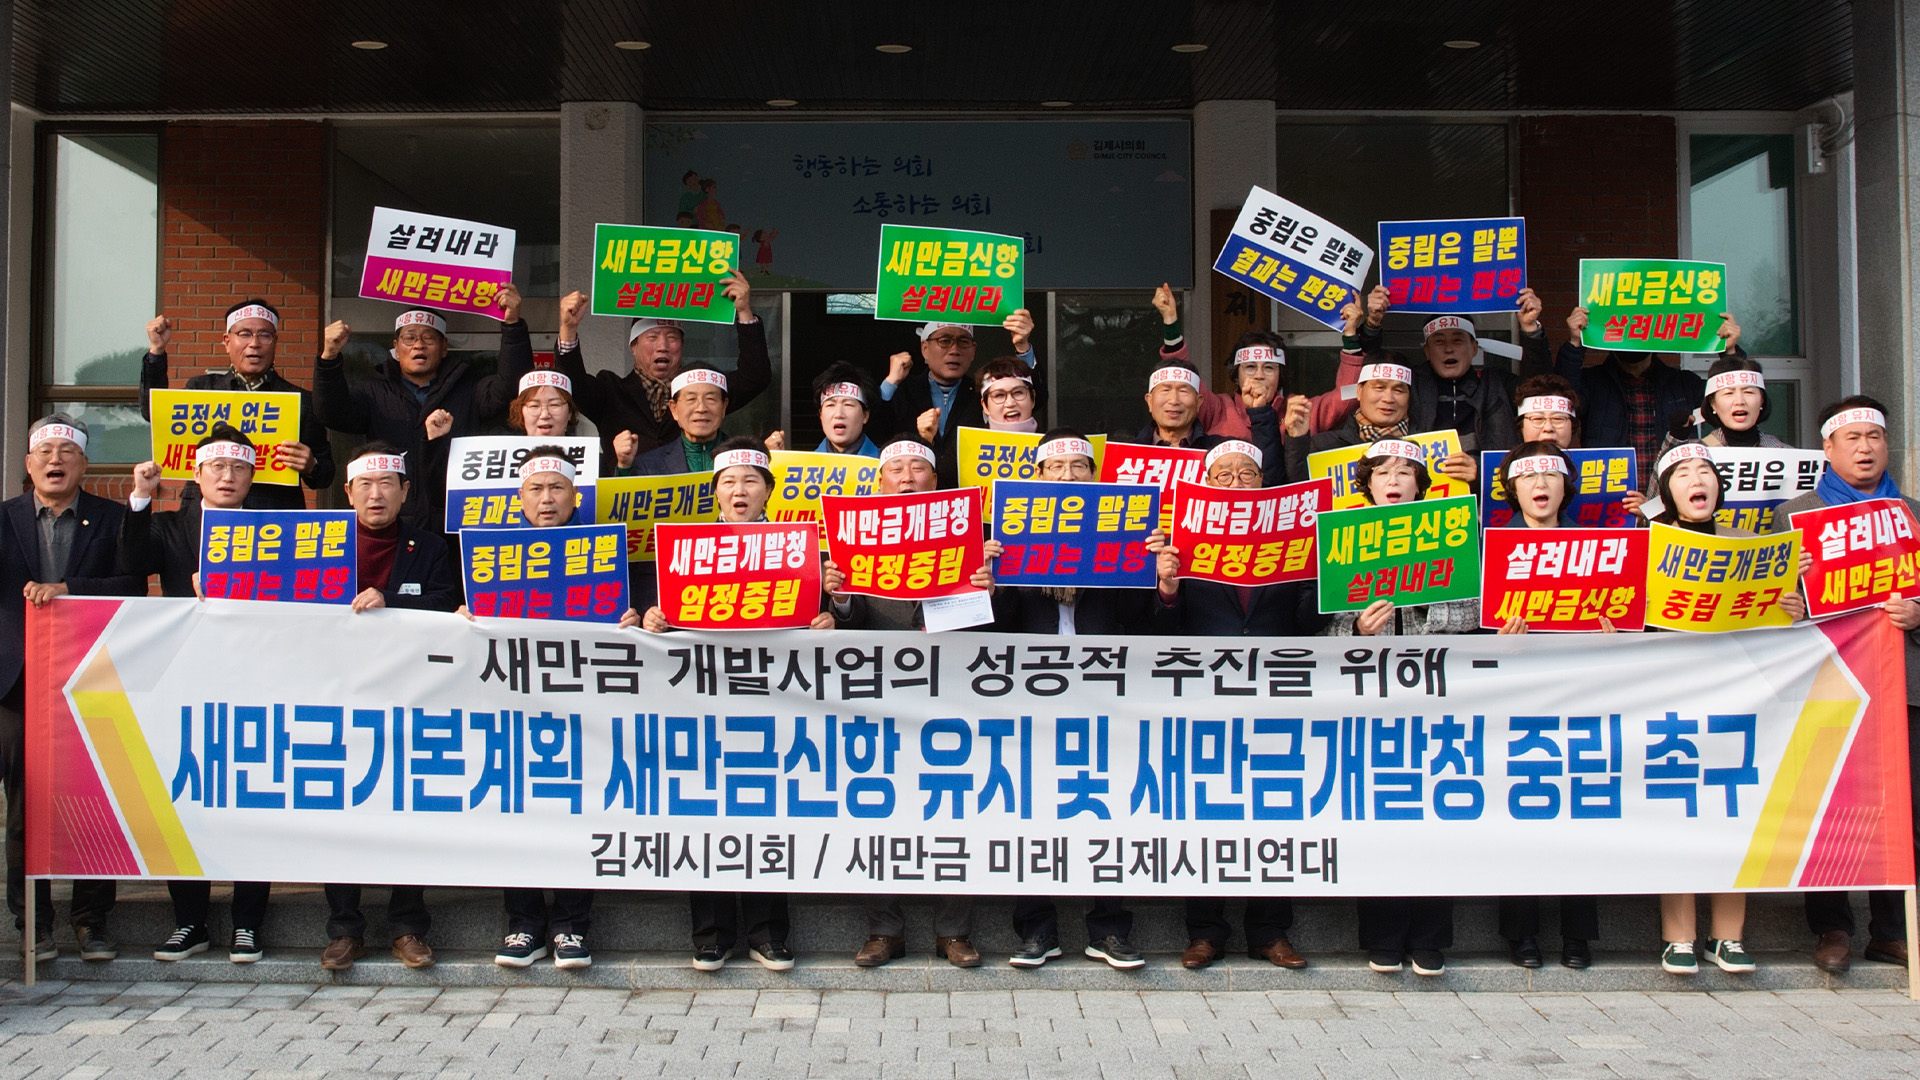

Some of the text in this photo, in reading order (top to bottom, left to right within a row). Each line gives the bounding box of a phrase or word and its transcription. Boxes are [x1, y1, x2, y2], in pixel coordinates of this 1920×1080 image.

[1094, 140, 1145, 151] 김제시의회
[1094, 152, 1167, 160] GIMJE CITY COUNCIL
[792, 154, 932, 178] 행동하는 의회
[852, 191, 992, 216] 소통하는 의회
[387, 224, 499, 258] 살려내라
[601, 239, 733, 274] 새만금신항
[1250, 207, 1364, 275] 중립은 말뿐
[1388, 226, 1518, 270] 중립은 말뿐
[886, 241, 1018, 278] 새만금신항
[376, 268, 498, 307] 새만금신항
[616, 282, 714, 308] 살려내라
[1230, 247, 1348, 310] 결과는 편향
[1388, 268, 1522, 304] 결과는 편향
[1587, 270, 1721, 306] 새만금신항
[234, 307, 274, 322] 신항 유지
[901, 285, 1002, 313] 살려내라
[415, 312, 435, 326] 유지
[1438, 317, 1459, 328] 유지
[1604, 313, 1704, 342] 살려내라
[1236, 348, 1274, 362] 신항 유지
[527, 373, 568, 388] 신항 유지
[686, 370, 727, 388] 신항 유지
[1152, 369, 1192, 385] 신항 유지
[1372, 365, 1410, 382] 신항 유지
[1716, 372, 1758, 388] 신항 유지
[839, 384, 859, 397] 유지
[1532, 397, 1554, 410] 신항
[52, 425, 75, 439] 유지
[171, 402, 280, 435] 공정성 없는
[1829, 409, 1875, 431] 신항 유지
[205, 444, 251, 459] 신항 유지
[366, 457, 388, 470] 신항
[728, 451, 751, 465] 신항
[884, 443, 927, 460] 신항 유지
[976, 444, 1039, 480] 공정성
[1046, 440, 1088, 457] 신항 유지
[1212, 442, 1256, 460] 신항 유지
[1377, 442, 1400, 455] 신항
[1670, 446, 1692, 462] 신항
[522, 459, 562, 479] 신항 유지
[783, 466, 847, 496] 공정성
[1116, 457, 1207, 492] 살려내
[1515, 458, 1560, 474] 신항 유지
[1580, 457, 1629, 495] 말뿐
[1715, 460, 1785, 492] 중립은
[837, 496, 970, 546] 새만금개발청
[1001, 496, 1085, 535] 중립은
[1097, 494, 1152, 532] 말뿐
[1181, 489, 1319, 535] 새만금개발청
[1578, 502, 1629, 527] 편향
[207, 520, 348, 563] 중립은 말뿐
[1326, 505, 1471, 565] 새만금신항
[1818, 506, 1913, 561] 살려내라
[472, 534, 618, 583] 중립은 말뿐
[669, 530, 807, 576] 새만금개발청
[850, 546, 965, 591] 엄정중립
[999, 541, 1150, 576] 결과는 편향
[1190, 536, 1314, 578] 엄정중립
[1506, 537, 1628, 580] 살려내라
[1656, 540, 1793, 583] 새만금개발청
[206, 567, 350, 600] 결과는 편향
[1347, 557, 1454, 603] 살려내라
[1820, 549, 1920, 605] 새만금신
[473, 581, 622, 619] 결과는 편향
[678, 579, 801, 622] 엄정중립
[1494, 586, 1635, 622] 새만금신항
[1661, 587, 1783, 622] 중립 촉구
[481, 638, 643, 695] 새만금
[668, 643, 940, 700] 개발사업의
[966, 645, 1127, 696] 성공적
[1151, 645, 1315, 699] 추진을
[1340, 645, 1449, 699] 위해
[172, 701, 1759, 822] 새만금기본계획 새만금신항 유지 및 새만금개발청 중립 촉구
[590, 831, 1339, 885] 김제시의회 / 새만금 미래 김제시민연대
